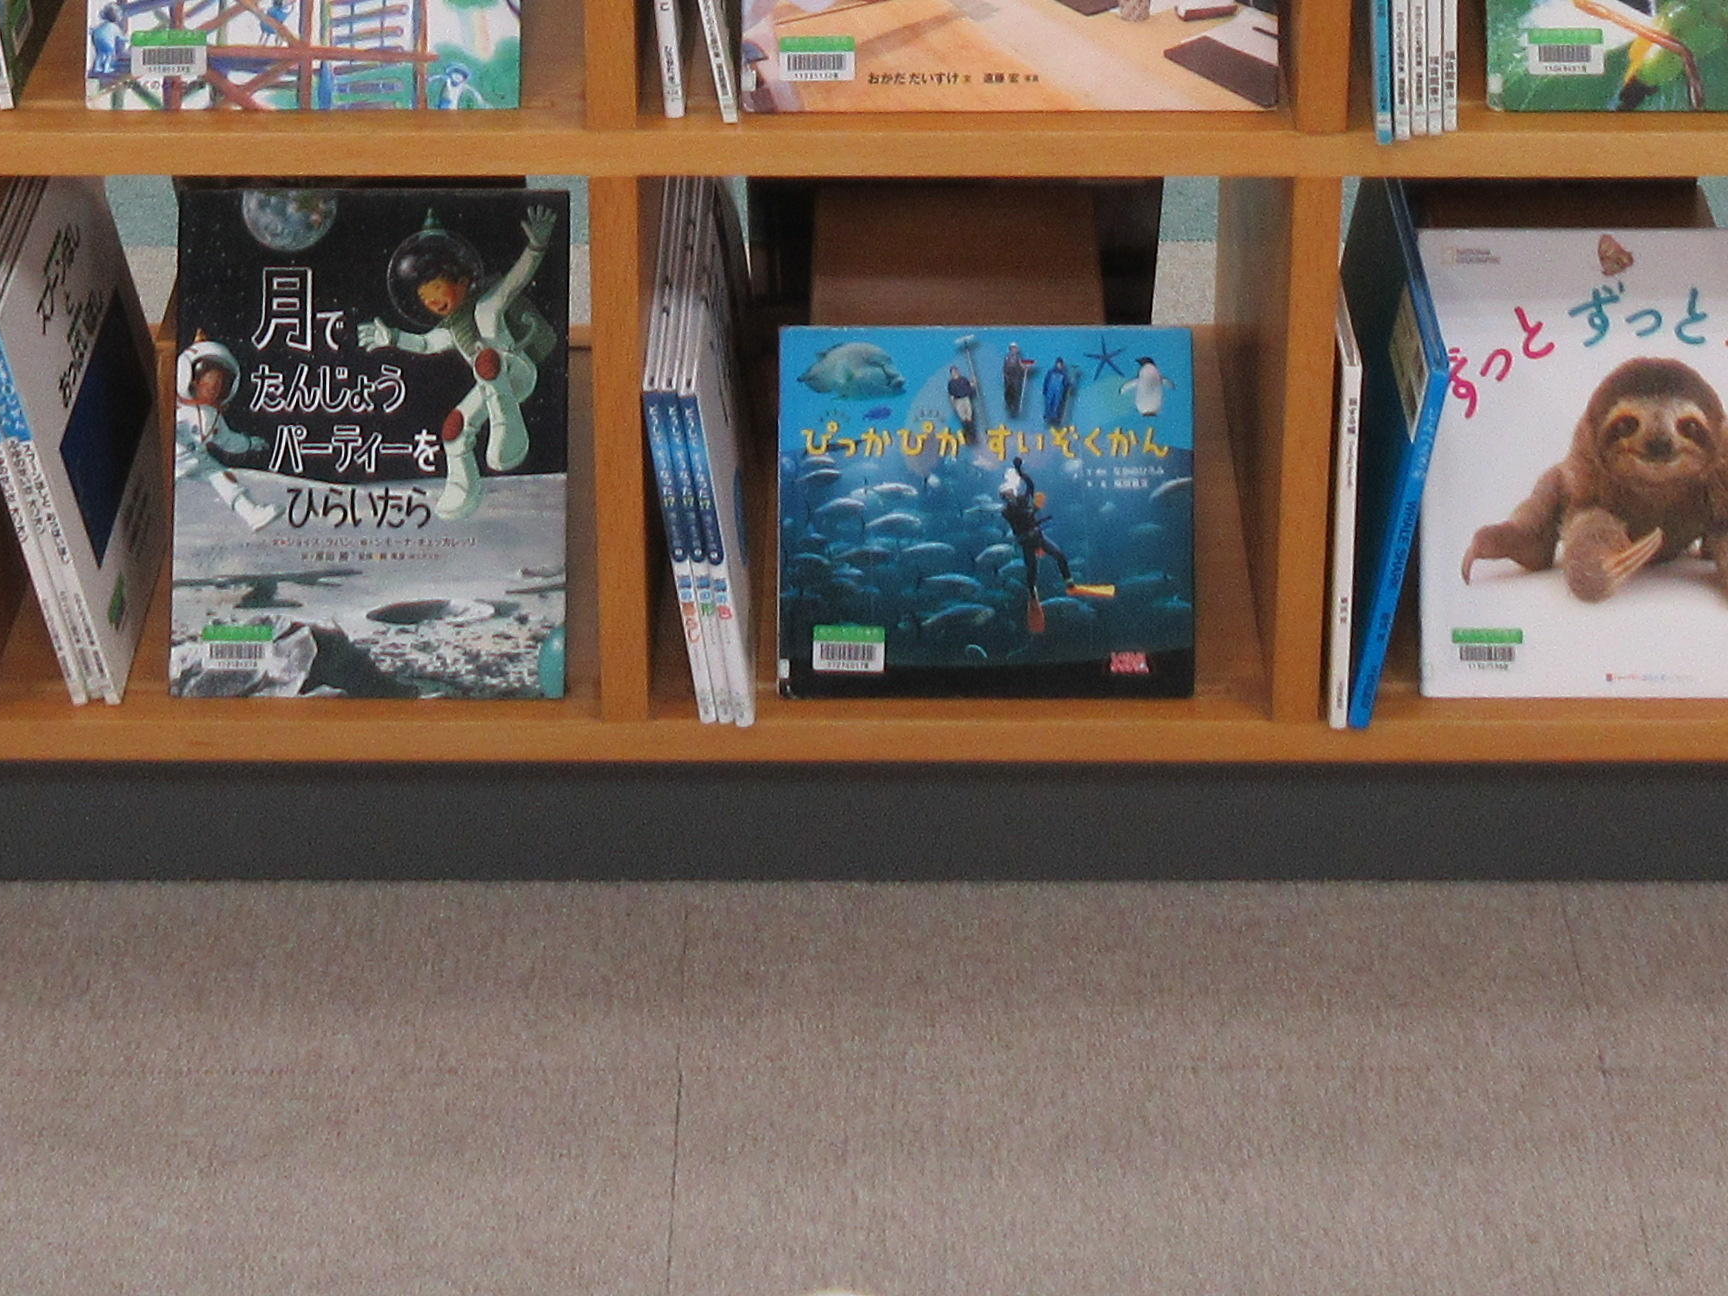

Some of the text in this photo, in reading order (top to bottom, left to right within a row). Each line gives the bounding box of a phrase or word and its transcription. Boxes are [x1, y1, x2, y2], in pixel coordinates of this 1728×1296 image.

[251, 267, 346, 351] 月で
[1567, 281, 1708, 348] ずっと
[249, 363, 406, 414] たんじょう
[268, 425, 443, 473] パーティーを
[801, 421, 1170, 459] ぴっかぴか すいぞくかん
[287, 485, 432, 529] ひらいたら
[1400, 500, 1419, 539] WHALE
